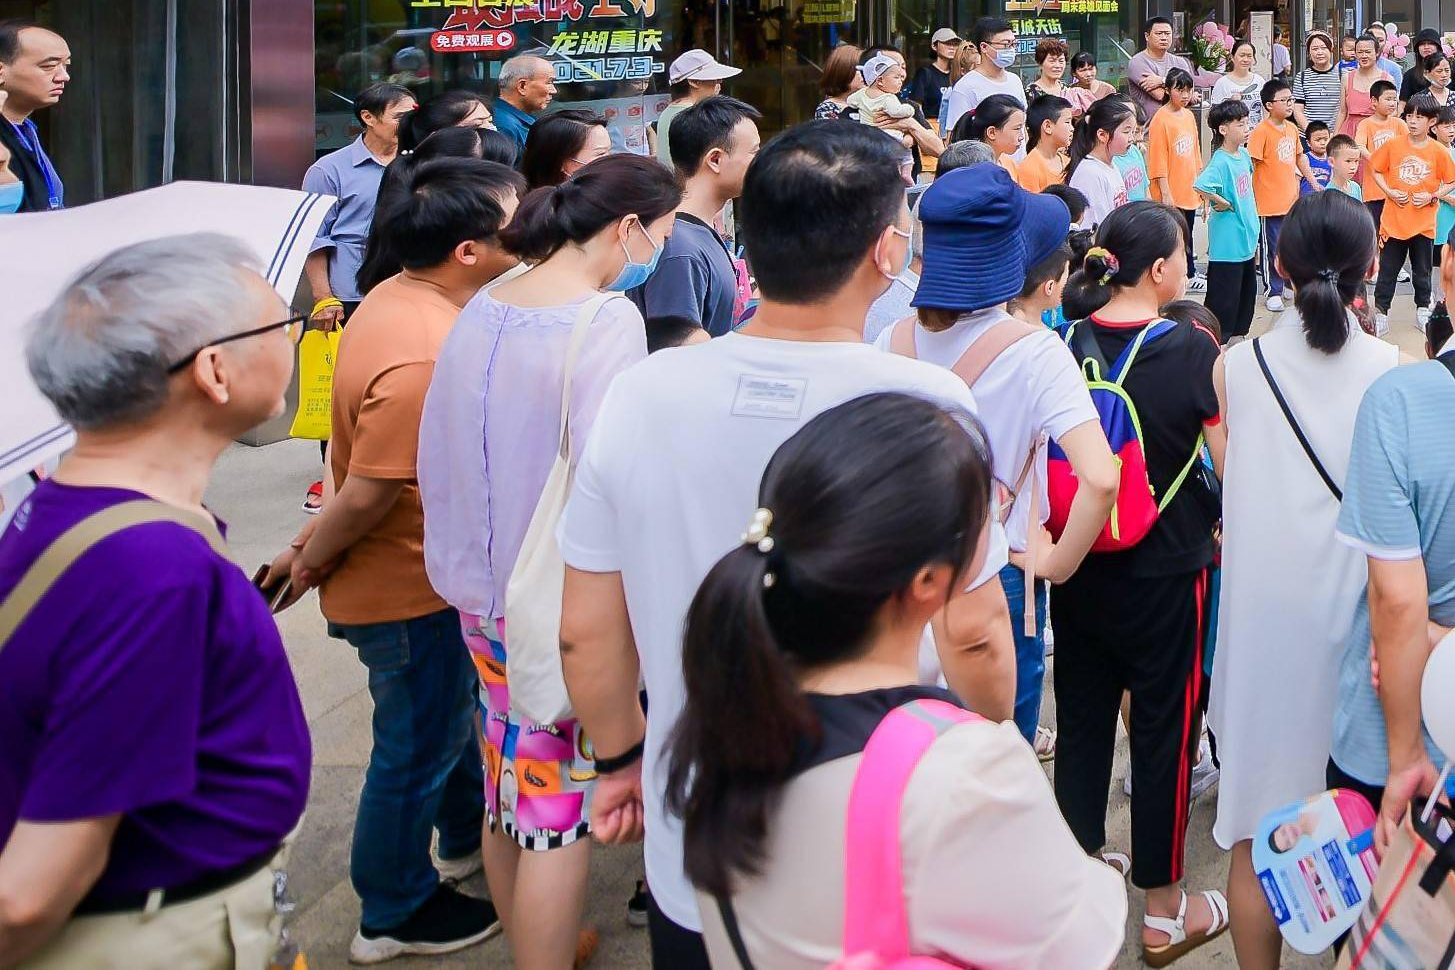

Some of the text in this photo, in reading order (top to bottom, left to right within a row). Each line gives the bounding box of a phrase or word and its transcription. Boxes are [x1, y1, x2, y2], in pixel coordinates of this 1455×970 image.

[436, 33, 494, 48] 免费观展
[546, 28, 663, 56] 龙湖重庆
